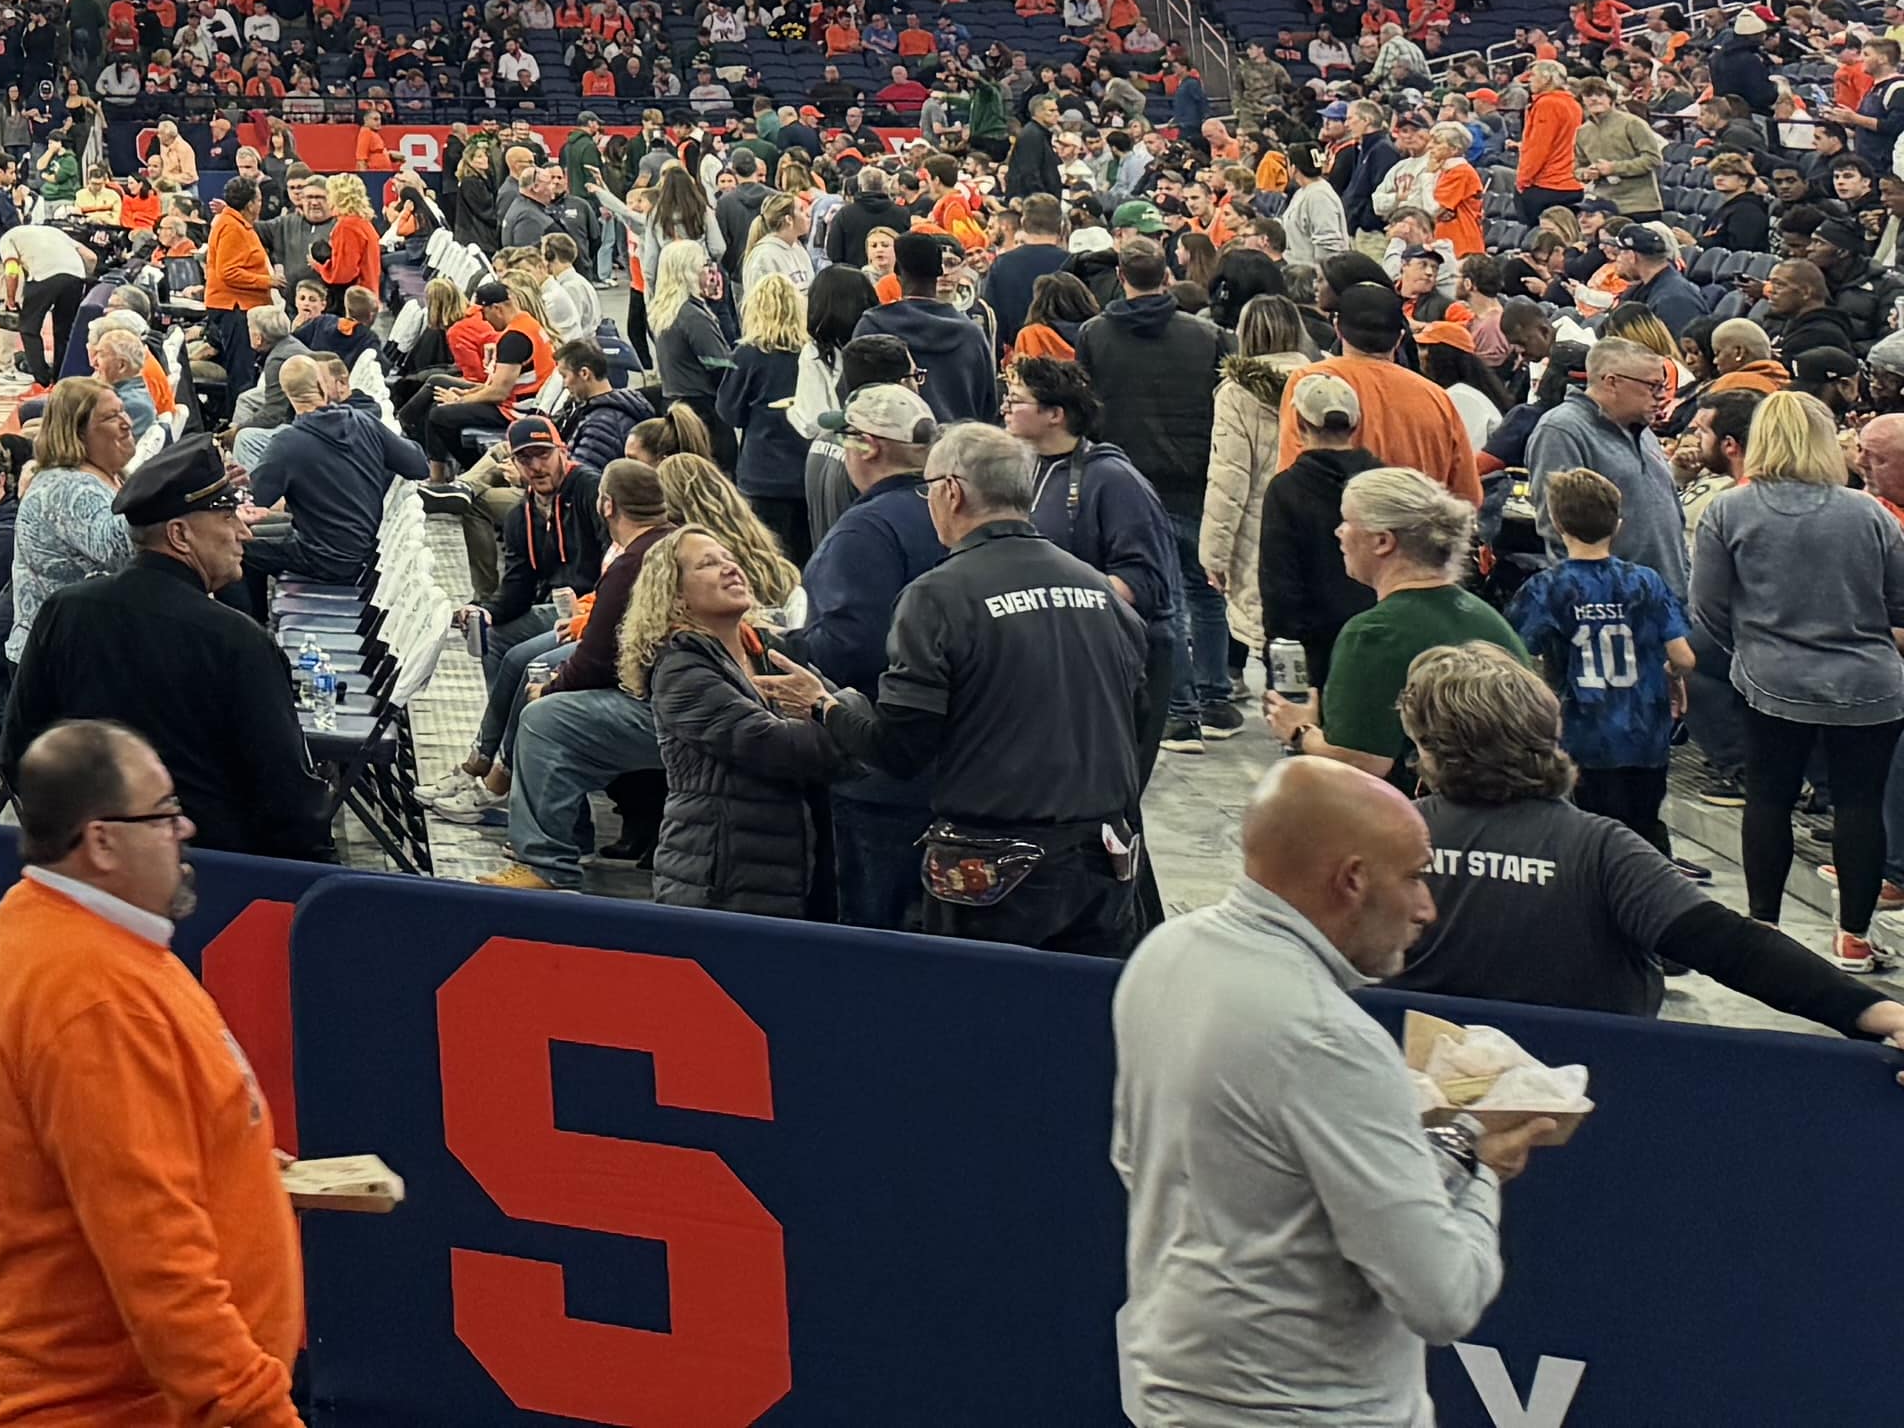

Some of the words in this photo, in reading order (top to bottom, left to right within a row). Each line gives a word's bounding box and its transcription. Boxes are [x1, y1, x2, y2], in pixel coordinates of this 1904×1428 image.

[985, 589, 1047, 619] EVENT
[1050, 586, 1108, 613] STAFF
[1574, 603, 1625, 620] MESSI
[1576, 623, 1640, 689] 10
[1467, 850, 1557, 887] STAFF
[434, 936, 793, 1428] S
